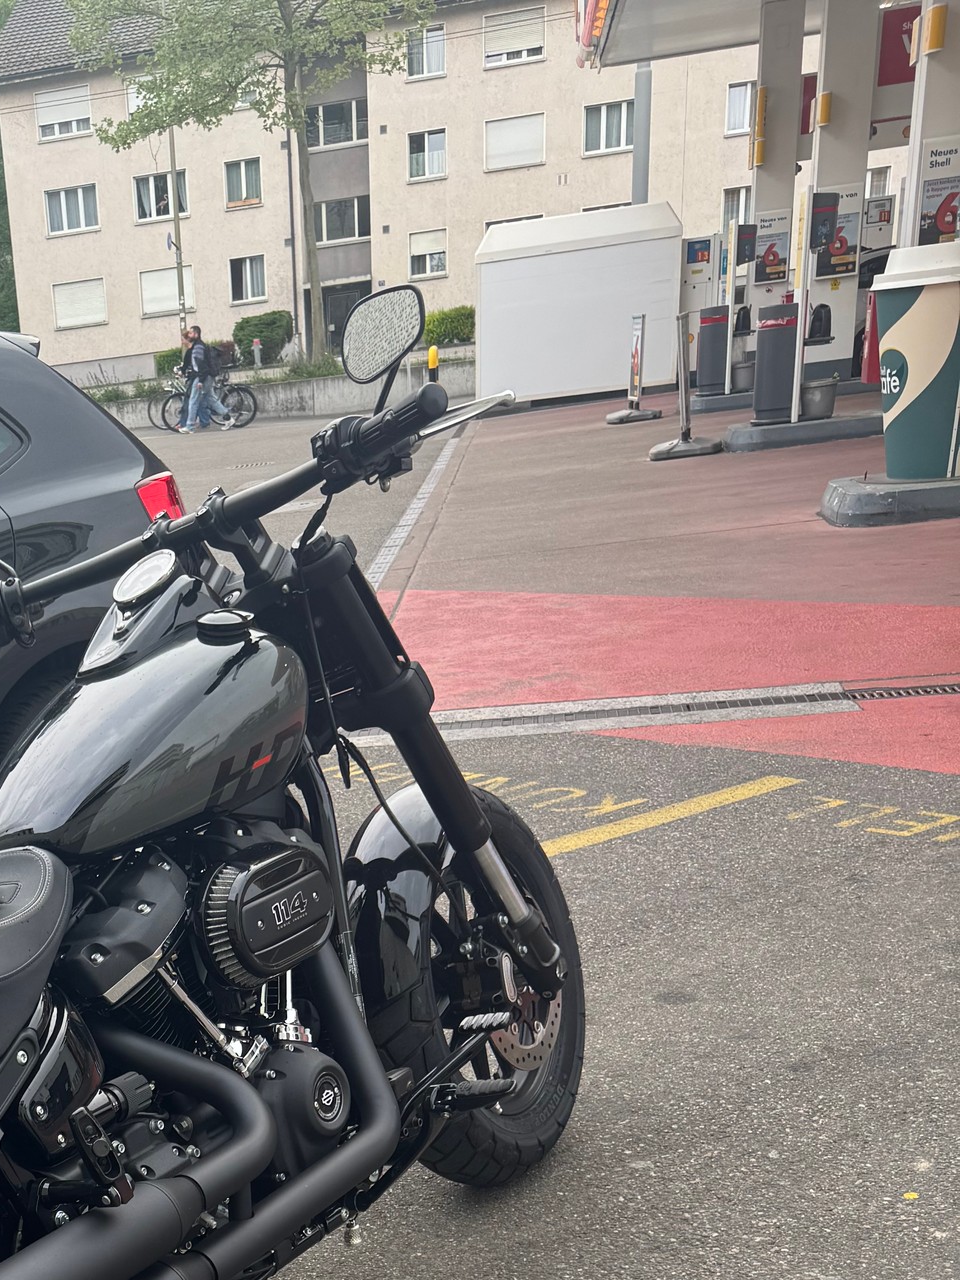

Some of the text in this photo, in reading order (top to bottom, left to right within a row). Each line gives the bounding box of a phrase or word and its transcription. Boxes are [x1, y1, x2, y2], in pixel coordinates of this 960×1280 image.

[929, 158, 951, 169] Shell
[930, 148, 959, 158] Neues
[935, 191, 960, 234] 6
[828, 226, 848, 255] 6
[764, 243, 780, 265] 6
[881, 368, 900, 394] afé
[272, 890, 308, 925] 114
